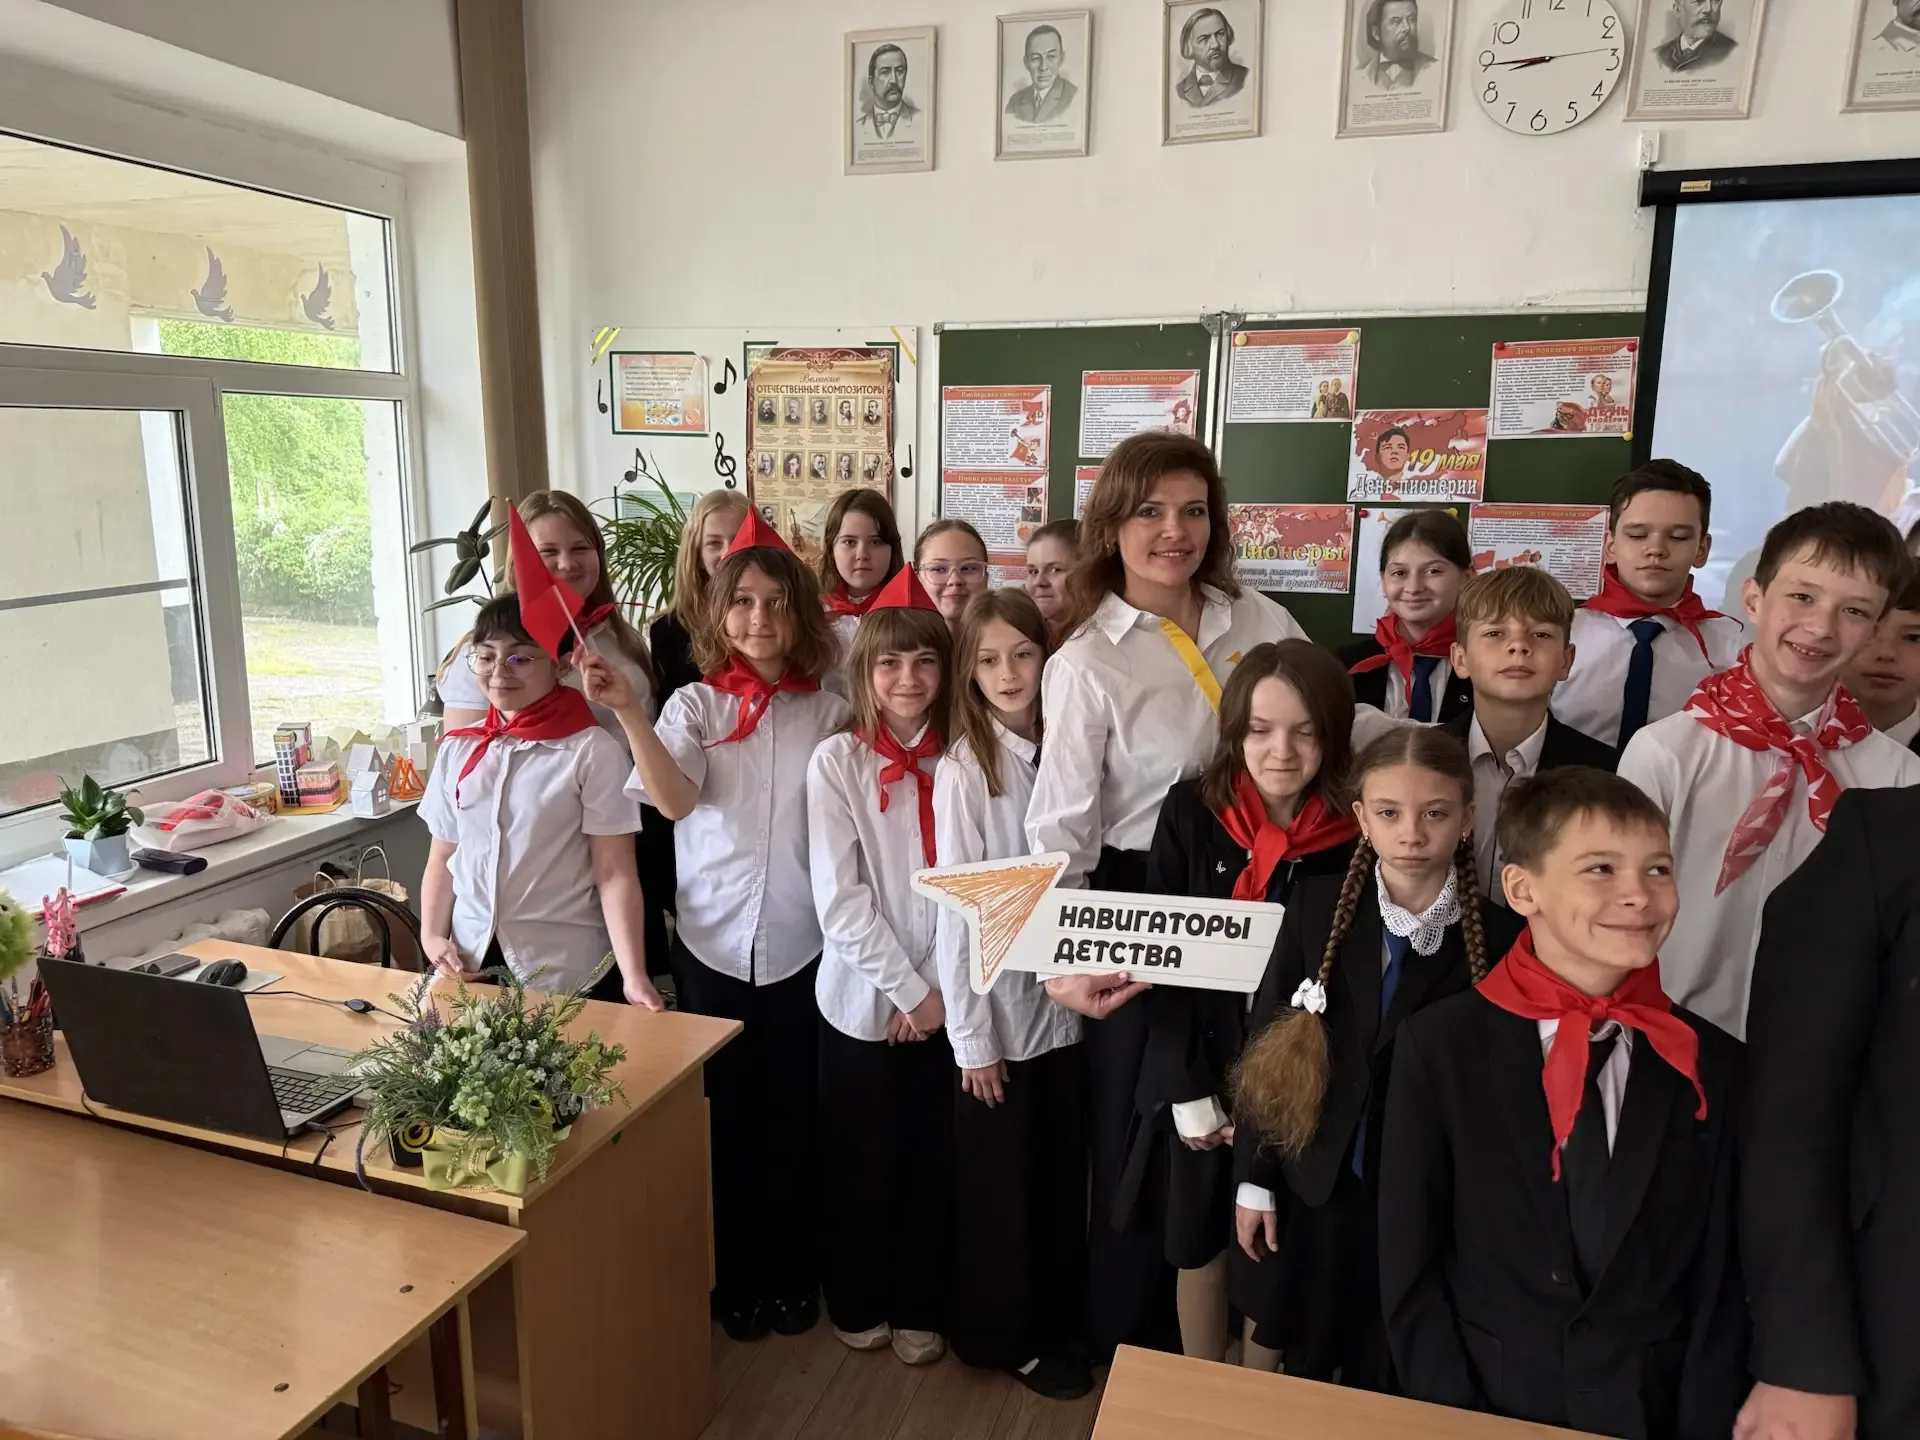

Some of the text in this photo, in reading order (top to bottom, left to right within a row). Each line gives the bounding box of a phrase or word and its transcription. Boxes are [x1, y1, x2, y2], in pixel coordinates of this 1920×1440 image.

[1492, 21, 1520, 45] 10
[1601, 15, 1616, 39] 2
[1478, 50, 1495, 73] 9
[1605, 48, 1620, 71] 3
[1483, 81, 1498, 104] 8
[1590, 80, 1604, 102] 4
[1505, 102, 1517, 124] 7
[1530, 109, 1547, 131] 6
[1565, 101, 1578, 124] 5
[756, 385, 885, 395] ОТЕЧЕСТВЕННЫЕ КОМПОЗИТОРЫ
[1408, 448, 1481, 472] 19 мая
[1355, 474, 1477, 500] День пионерии
[1058, 905, 1252, 940] НАВИГАТОРЫ
[1053, 937, 1183, 969] ДЕТСТВА
